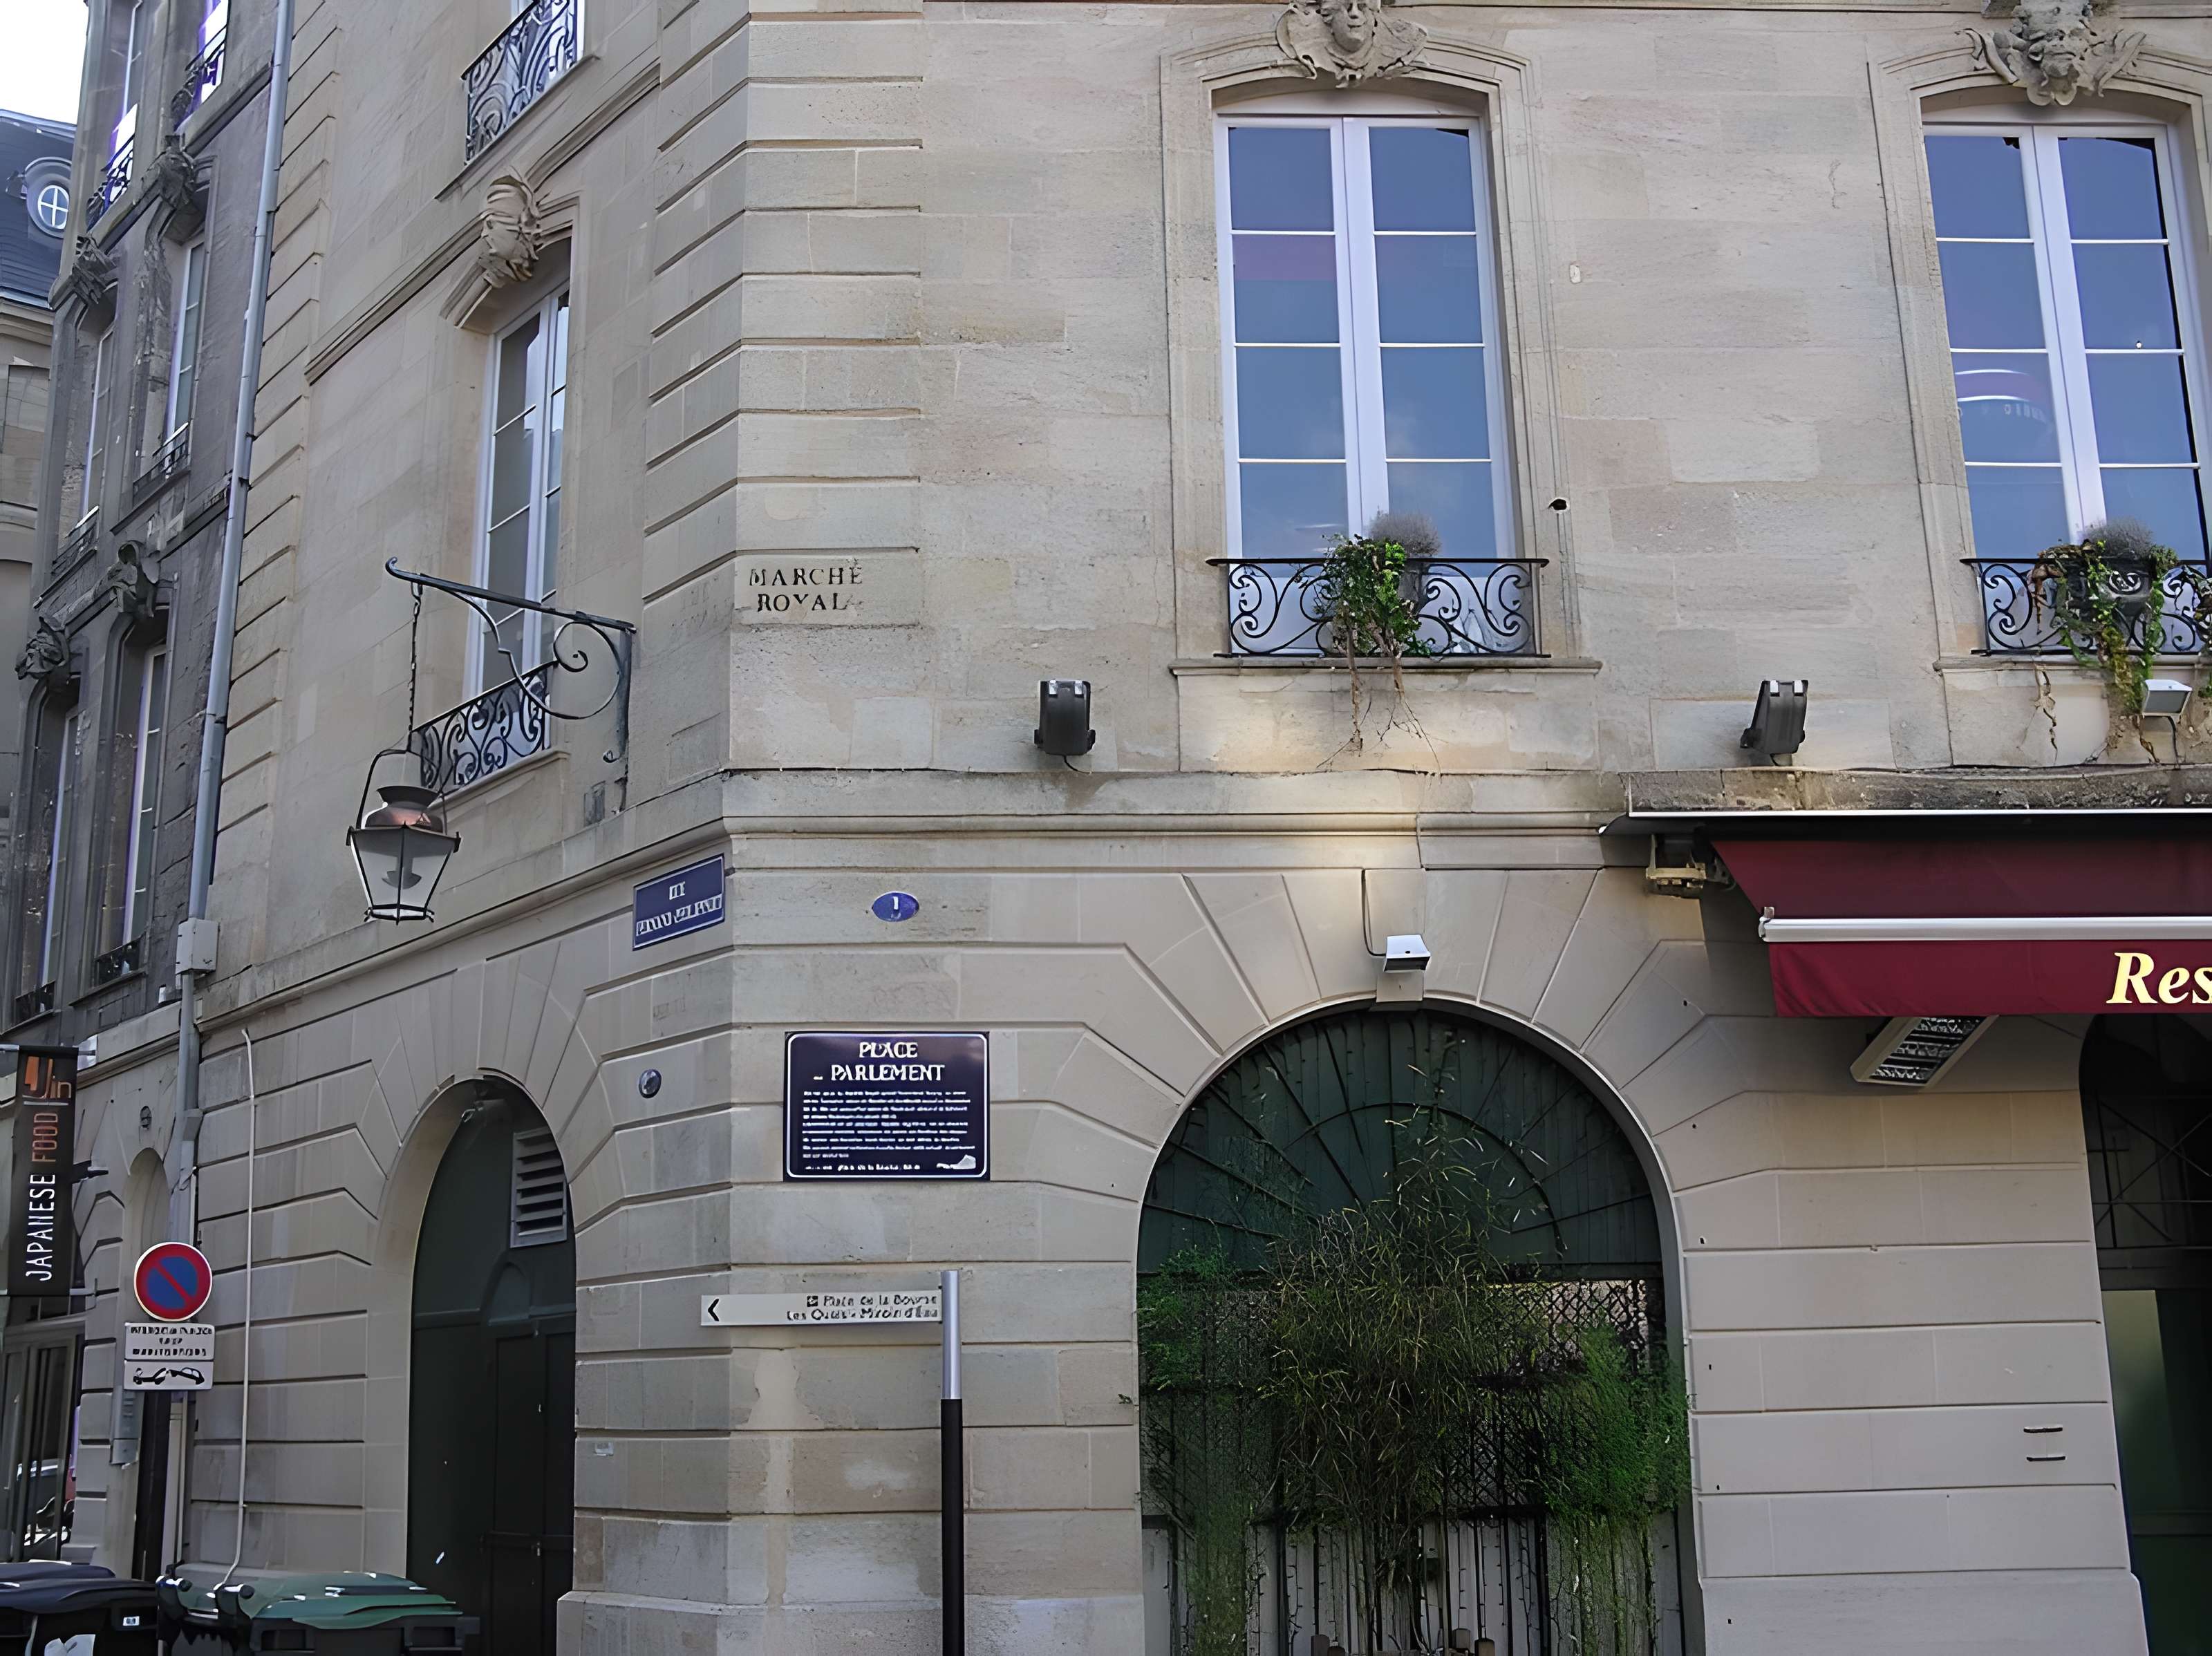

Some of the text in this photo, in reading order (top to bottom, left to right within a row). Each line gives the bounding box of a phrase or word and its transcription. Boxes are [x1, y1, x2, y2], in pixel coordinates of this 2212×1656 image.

[757, 592, 849, 612] ROYAL
[2106, 952, 2212, 1004] Res
[859, 1042, 919, 1058] PLACE
[831, 1064, 946, 1081] PARLEMENT
[25, 1113, 58, 1281] JAPANESE FOOD
